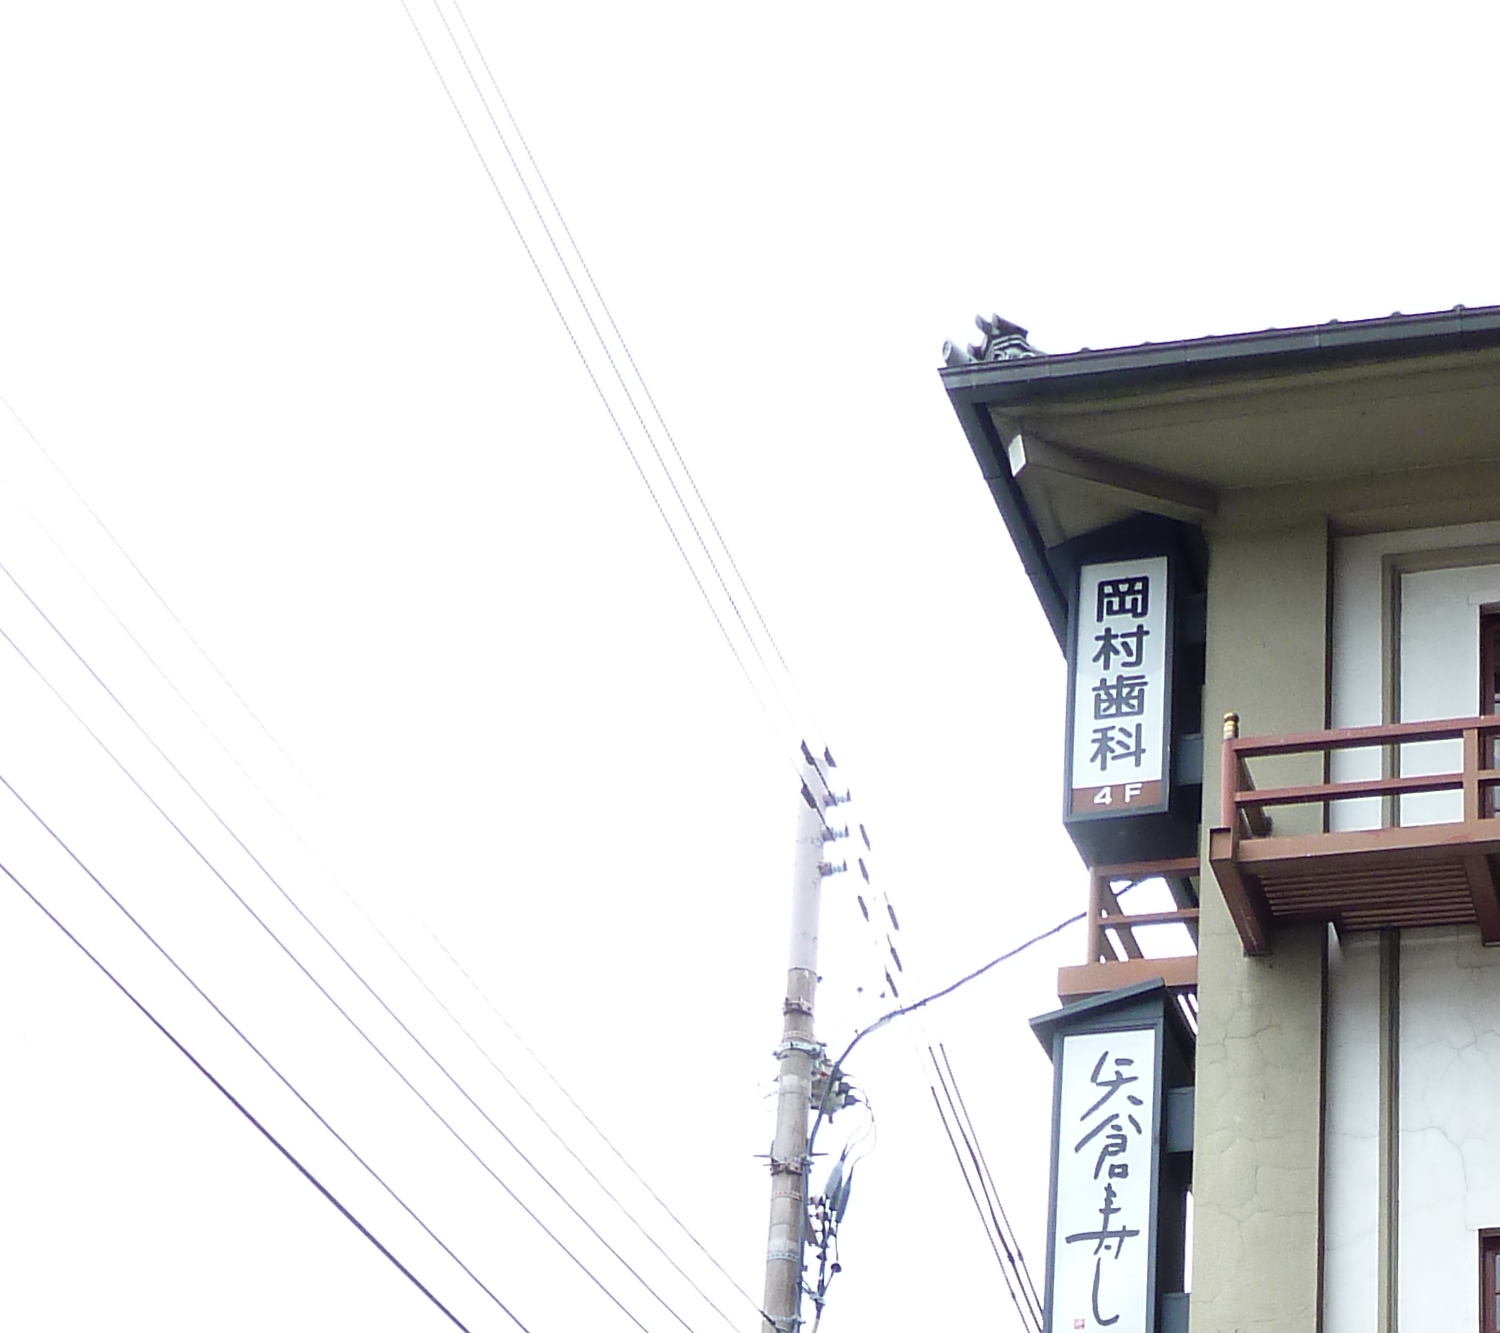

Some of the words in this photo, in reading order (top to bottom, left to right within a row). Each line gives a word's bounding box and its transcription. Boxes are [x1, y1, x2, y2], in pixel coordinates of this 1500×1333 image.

[1090, 576, 1150, 772] 岡村歯科
[1093, 783, 1143, 806] 4F
[1064, 1050, 1145, 1327] 矢倉寿し
